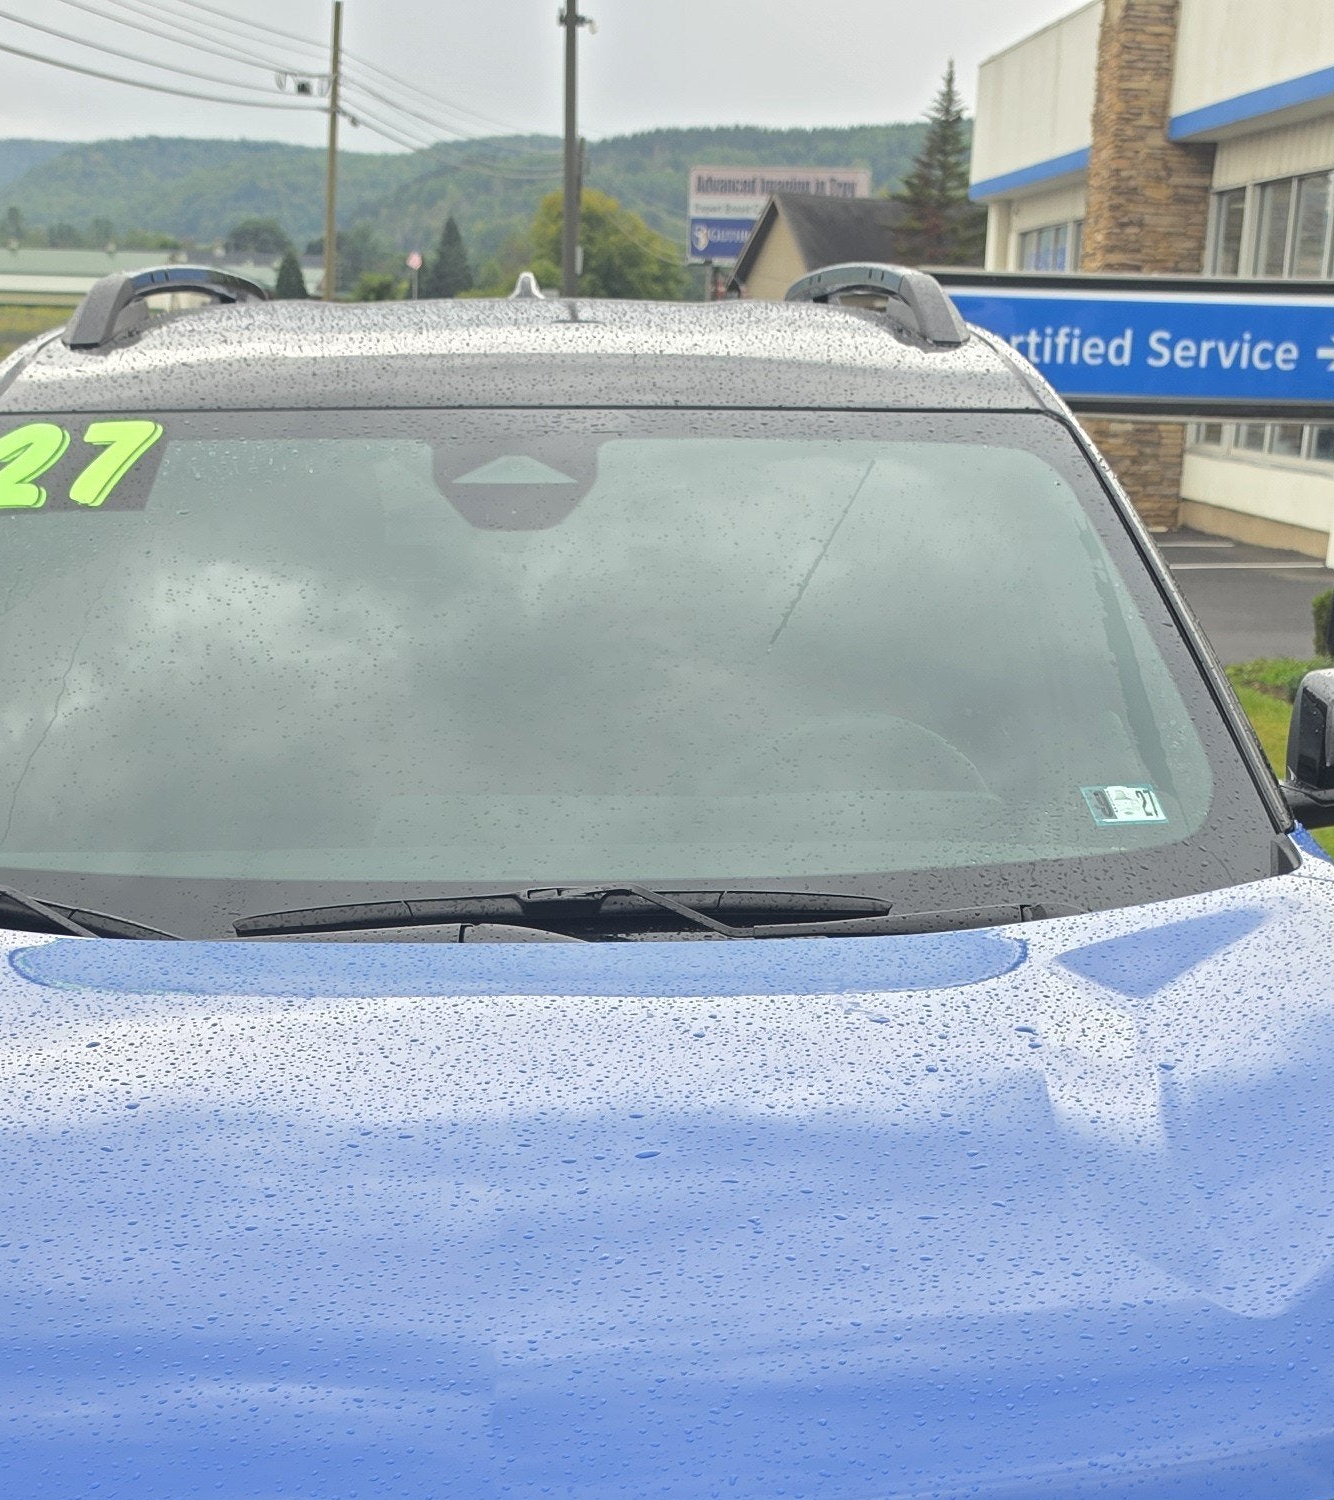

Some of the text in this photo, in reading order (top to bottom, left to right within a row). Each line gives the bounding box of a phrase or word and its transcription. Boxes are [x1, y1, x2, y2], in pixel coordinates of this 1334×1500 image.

[697, 174, 756, 194] Advanced
[1010, 325, 1299, 371] rtified Service
